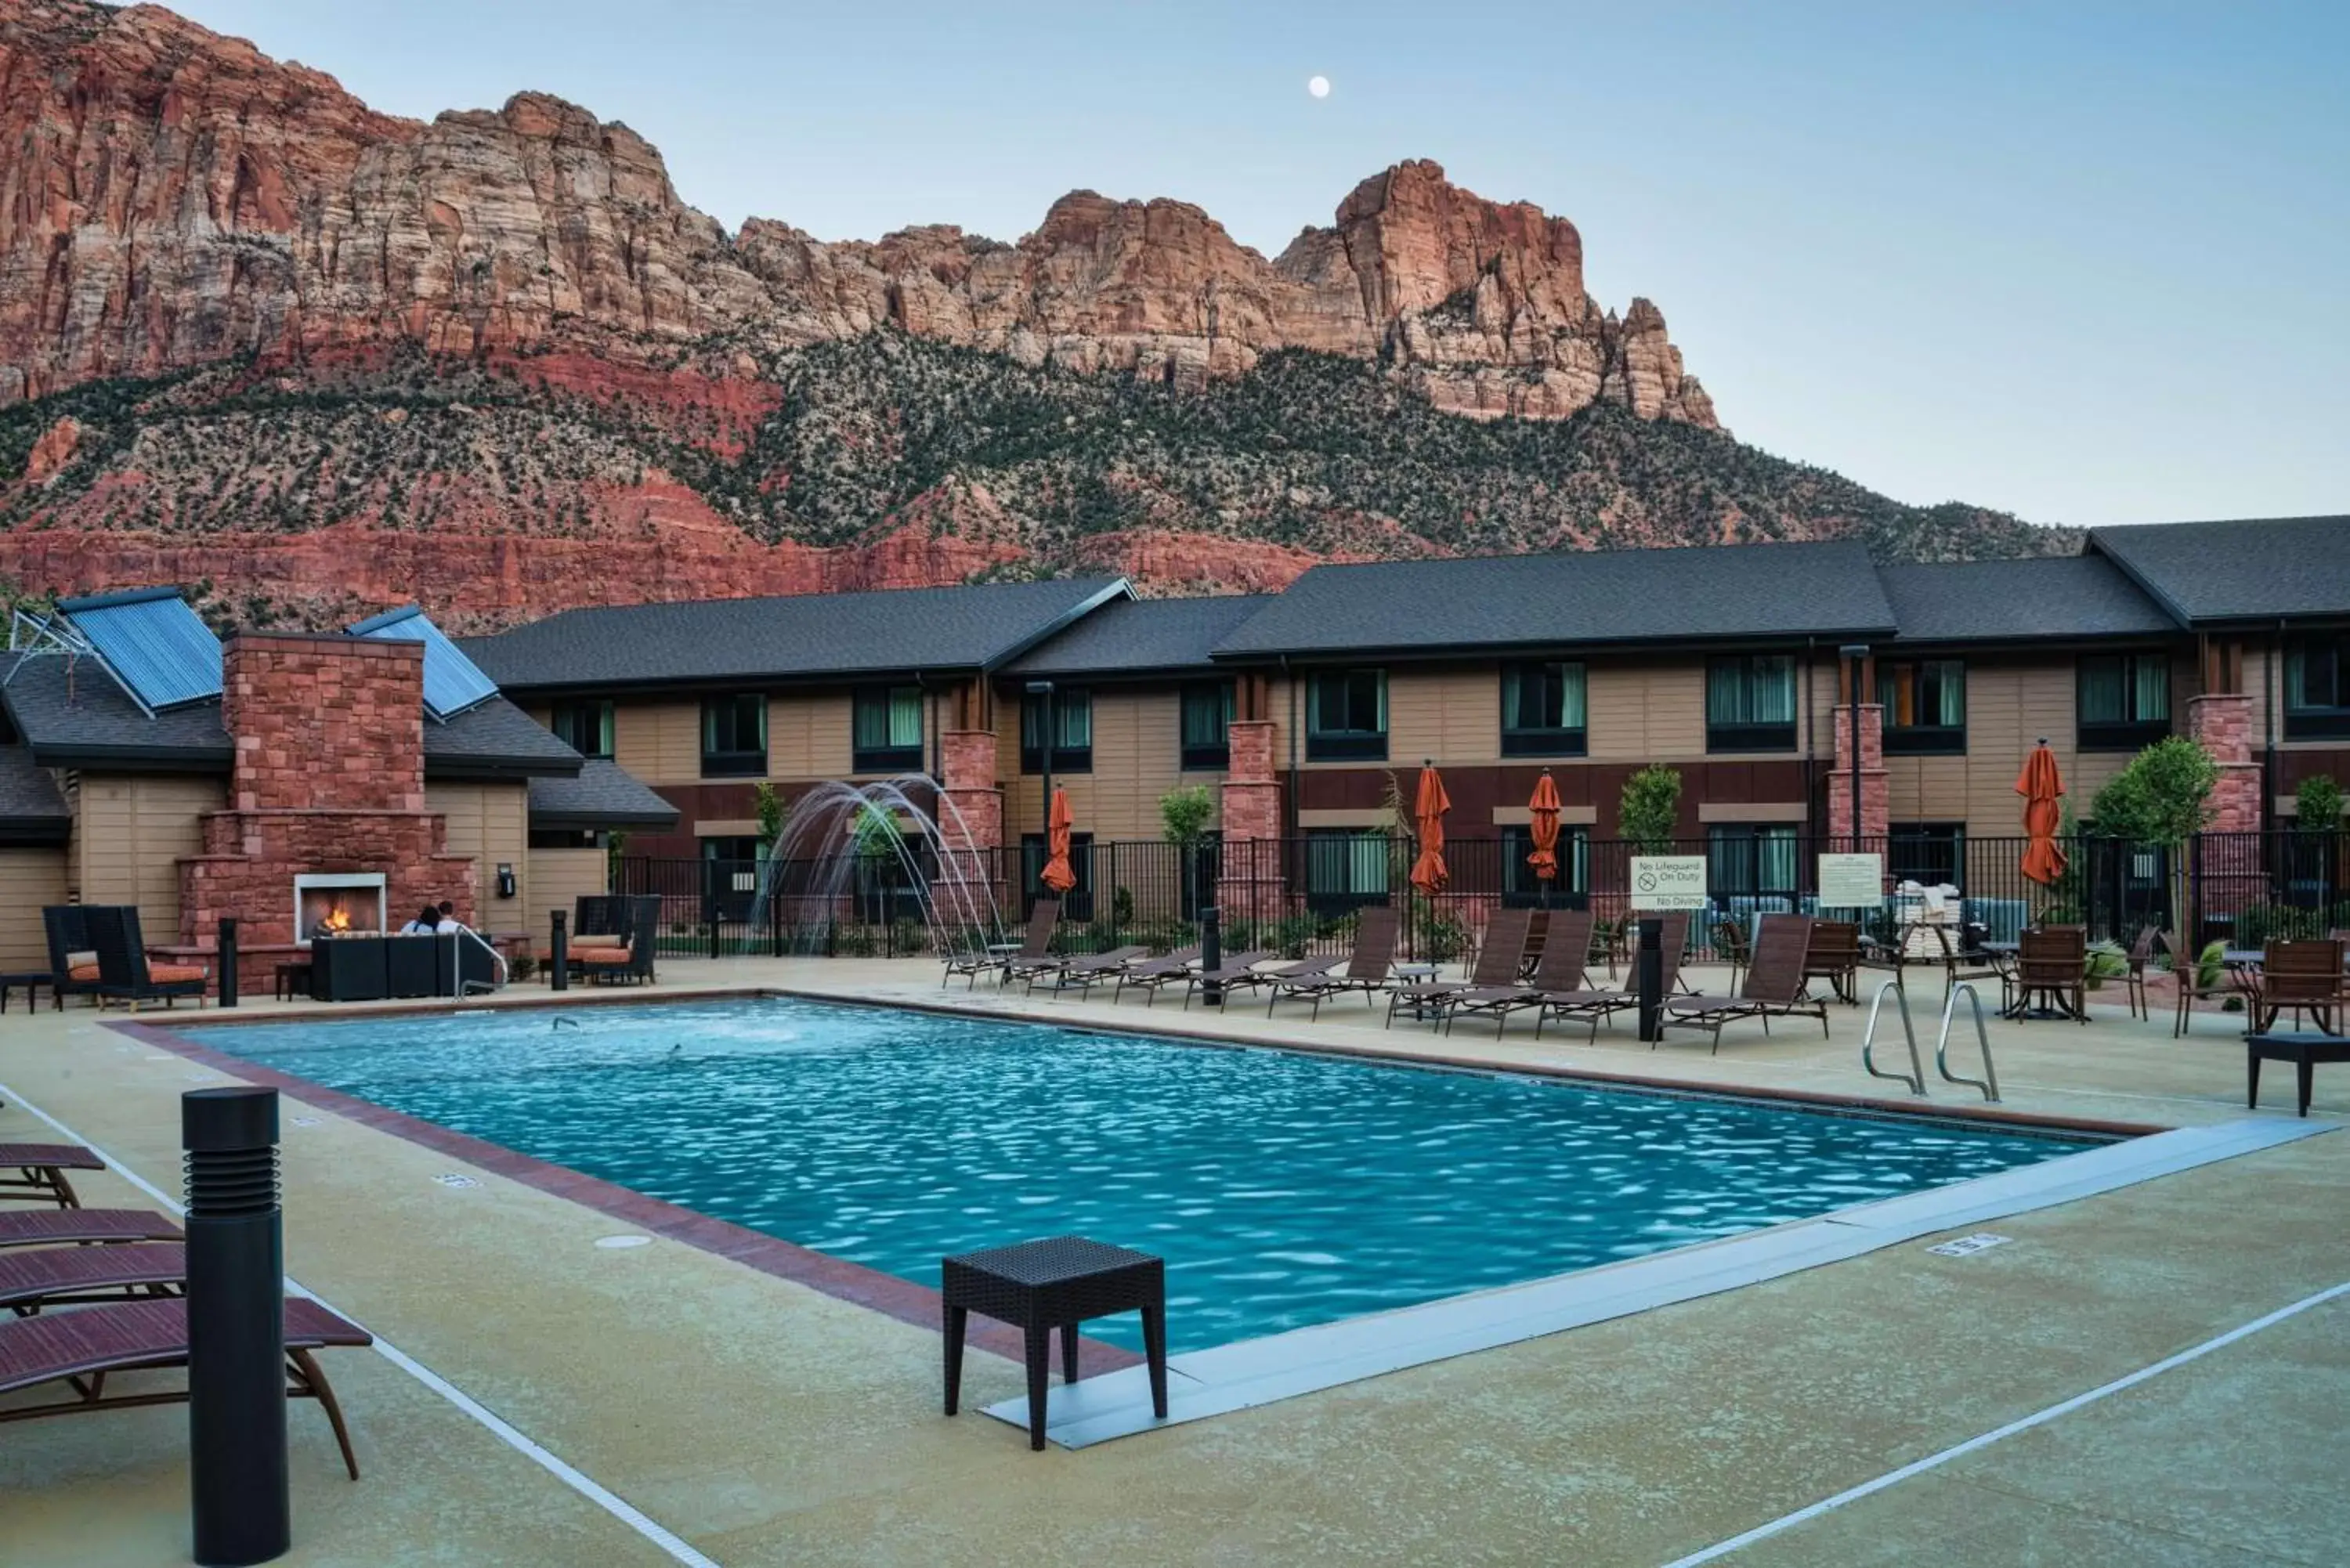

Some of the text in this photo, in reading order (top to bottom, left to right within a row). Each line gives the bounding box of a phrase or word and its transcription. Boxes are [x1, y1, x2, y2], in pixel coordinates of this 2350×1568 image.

[1640, 861, 1700, 872] No Lifeguard
[1660, 872, 1700, 882] On Duty
[1657, 897, 1671, 906] No
